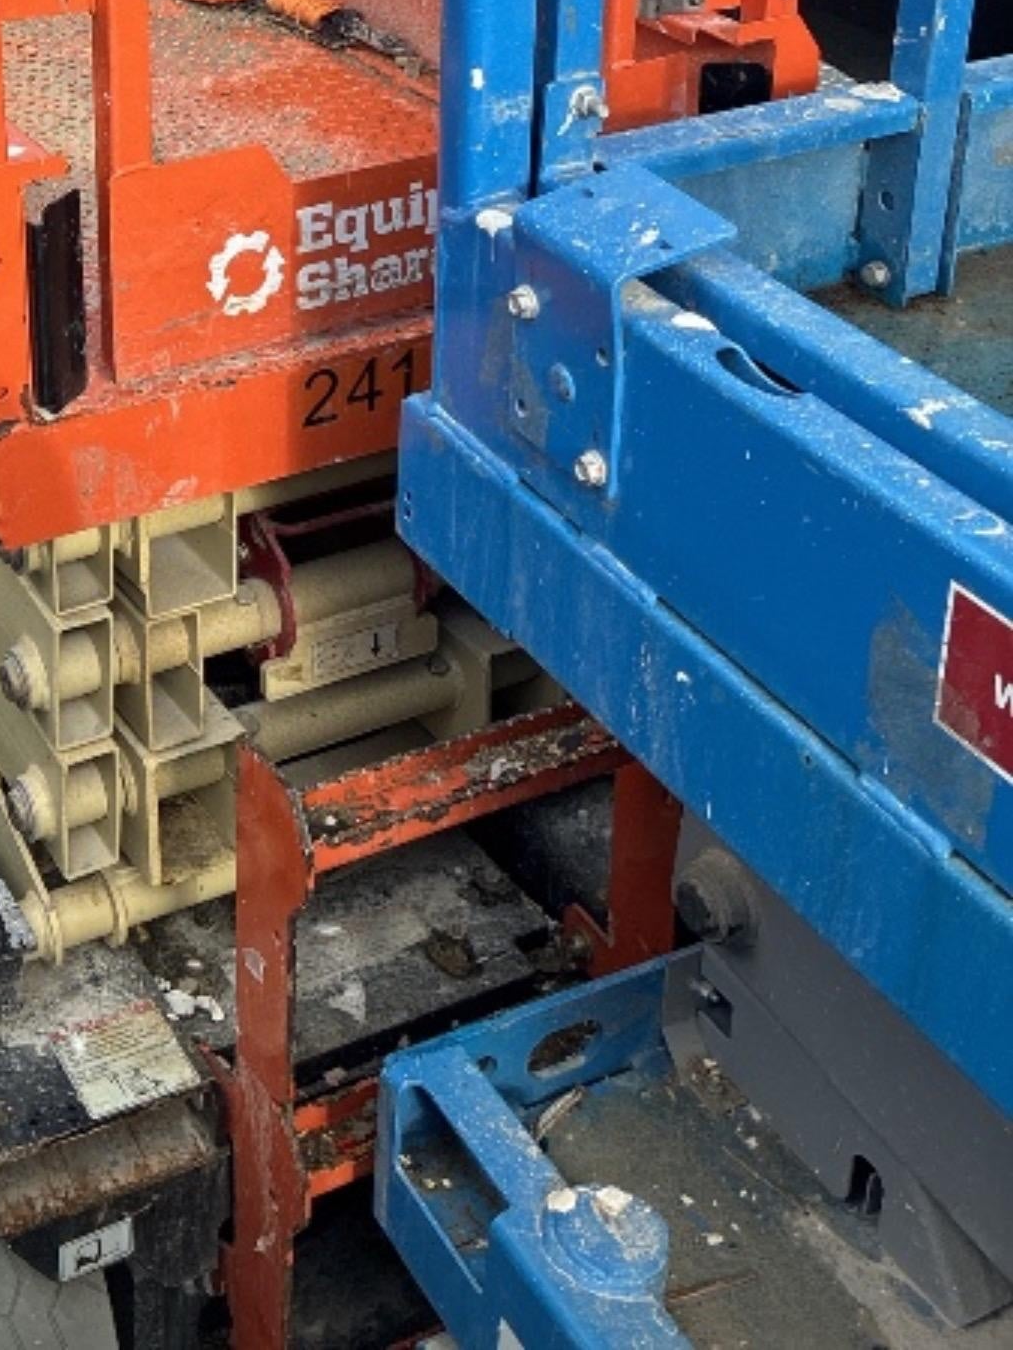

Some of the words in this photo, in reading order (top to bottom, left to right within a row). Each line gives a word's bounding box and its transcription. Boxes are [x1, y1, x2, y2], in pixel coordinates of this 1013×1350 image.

[295, 179, 438, 255] Equi
[296, 248, 435, 310] Shar
[301, 349, 417, 428] 241
